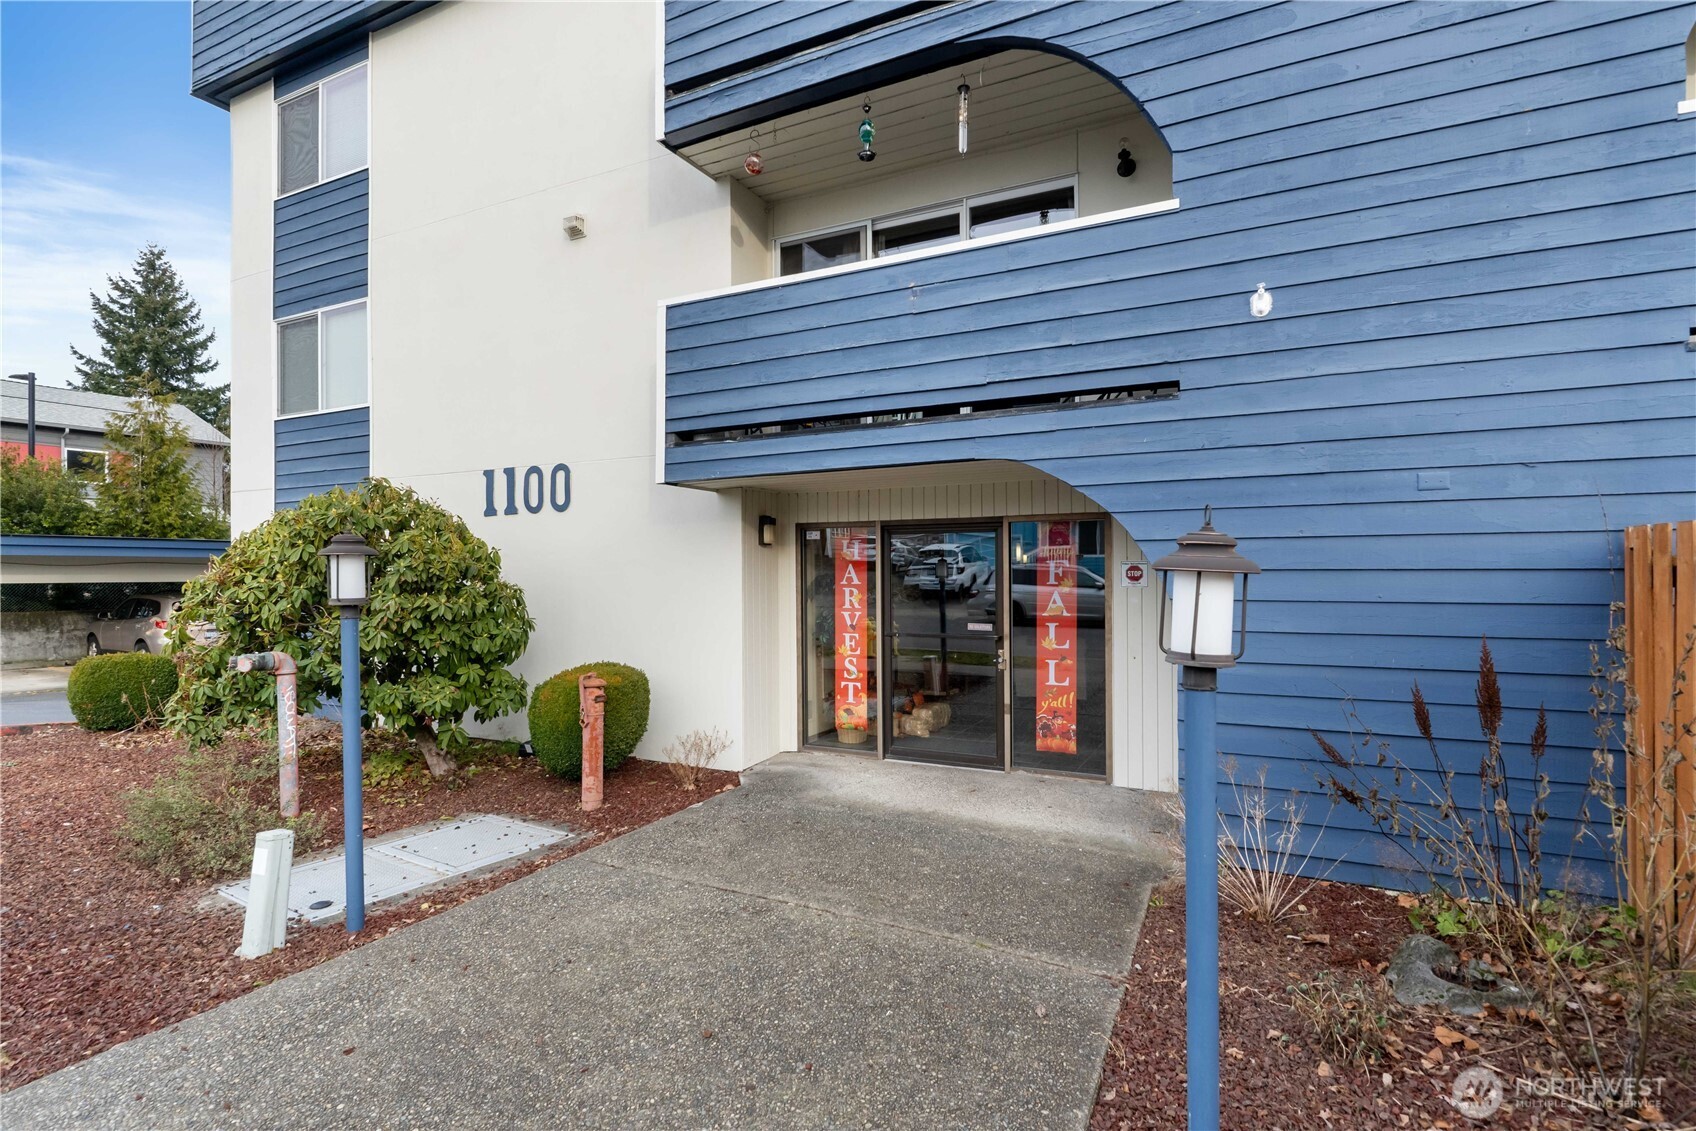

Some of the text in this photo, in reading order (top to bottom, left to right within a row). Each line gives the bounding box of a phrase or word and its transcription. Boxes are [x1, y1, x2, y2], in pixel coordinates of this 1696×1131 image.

[482, 463, 571, 517] 1100
[840, 539, 862, 704] HARVEST
[1041, 560, 1071, 686] FALL
[1038, 691, 1075, 715] y'all!
